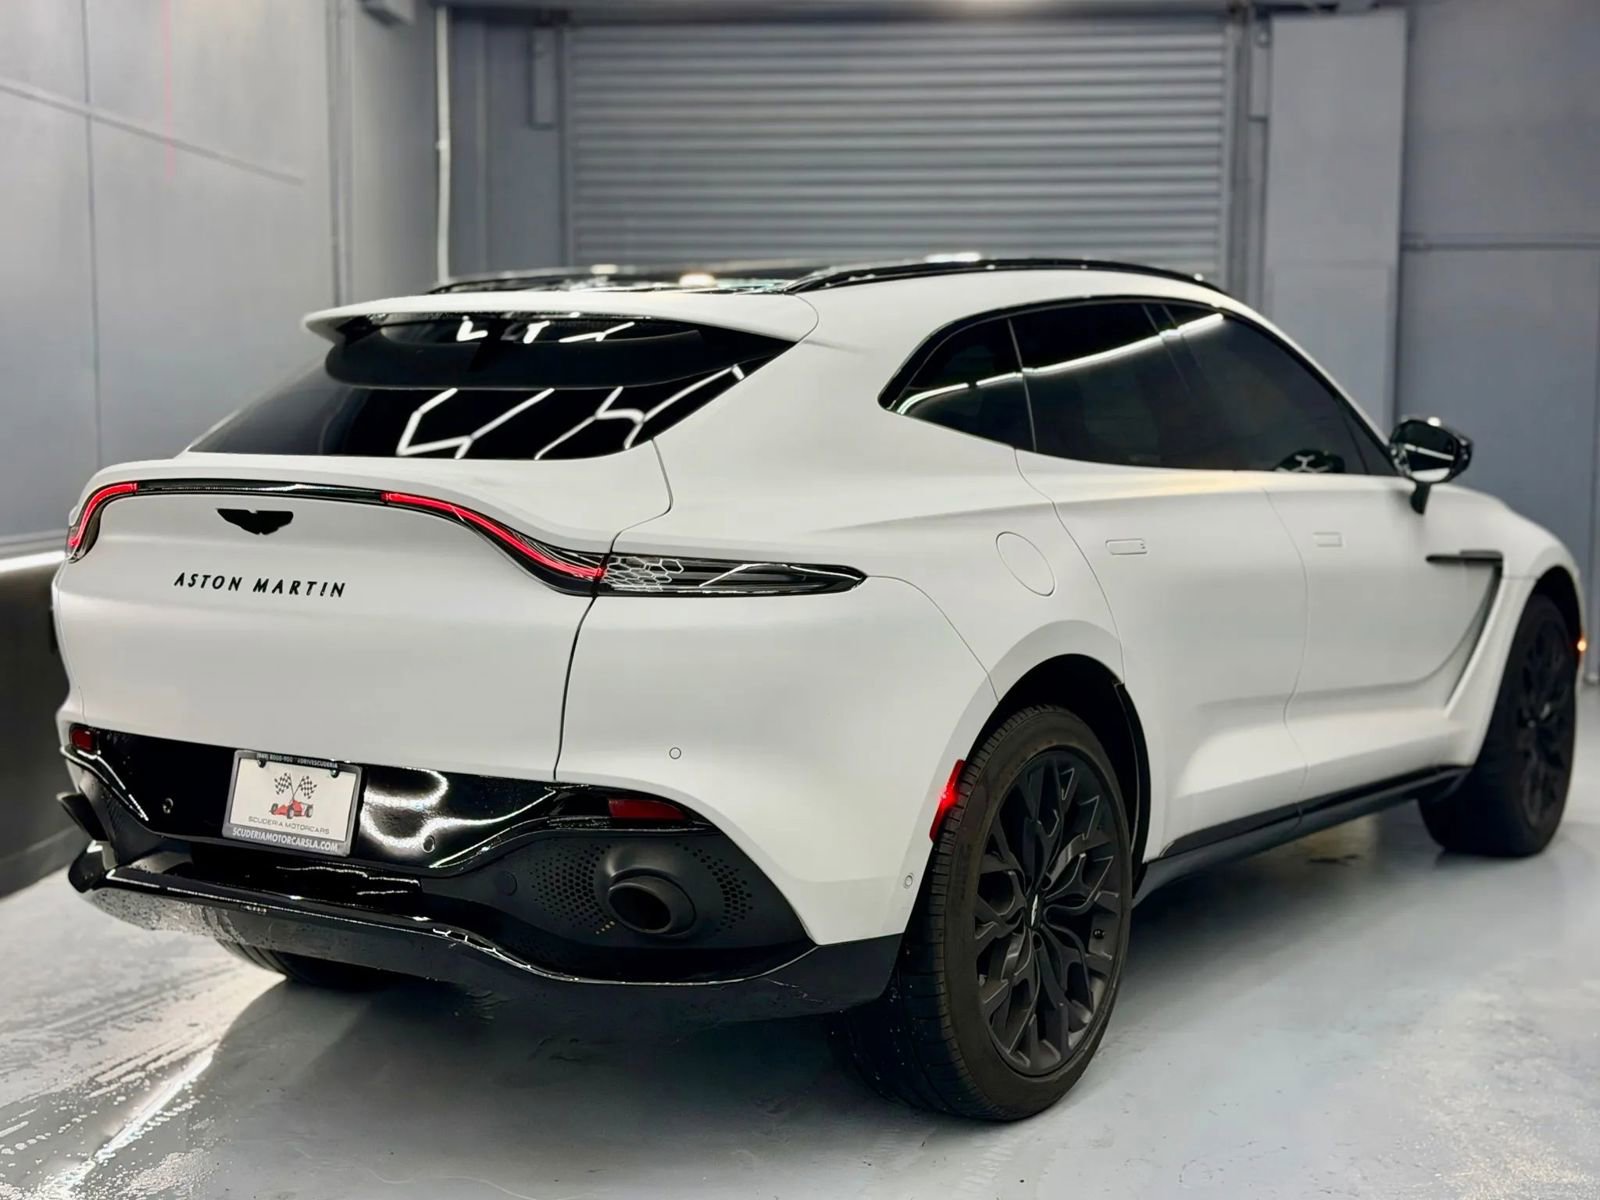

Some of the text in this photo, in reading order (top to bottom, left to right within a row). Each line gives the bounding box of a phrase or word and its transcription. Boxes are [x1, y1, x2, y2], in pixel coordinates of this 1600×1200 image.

[174, 572, 346, 598] ASTON MARTIN
[248, 816, 330, 834] SCUDERIA MOTORCARS
[232, 827, 338, 852] SCUDERIAMOTORCARSLA.COM
